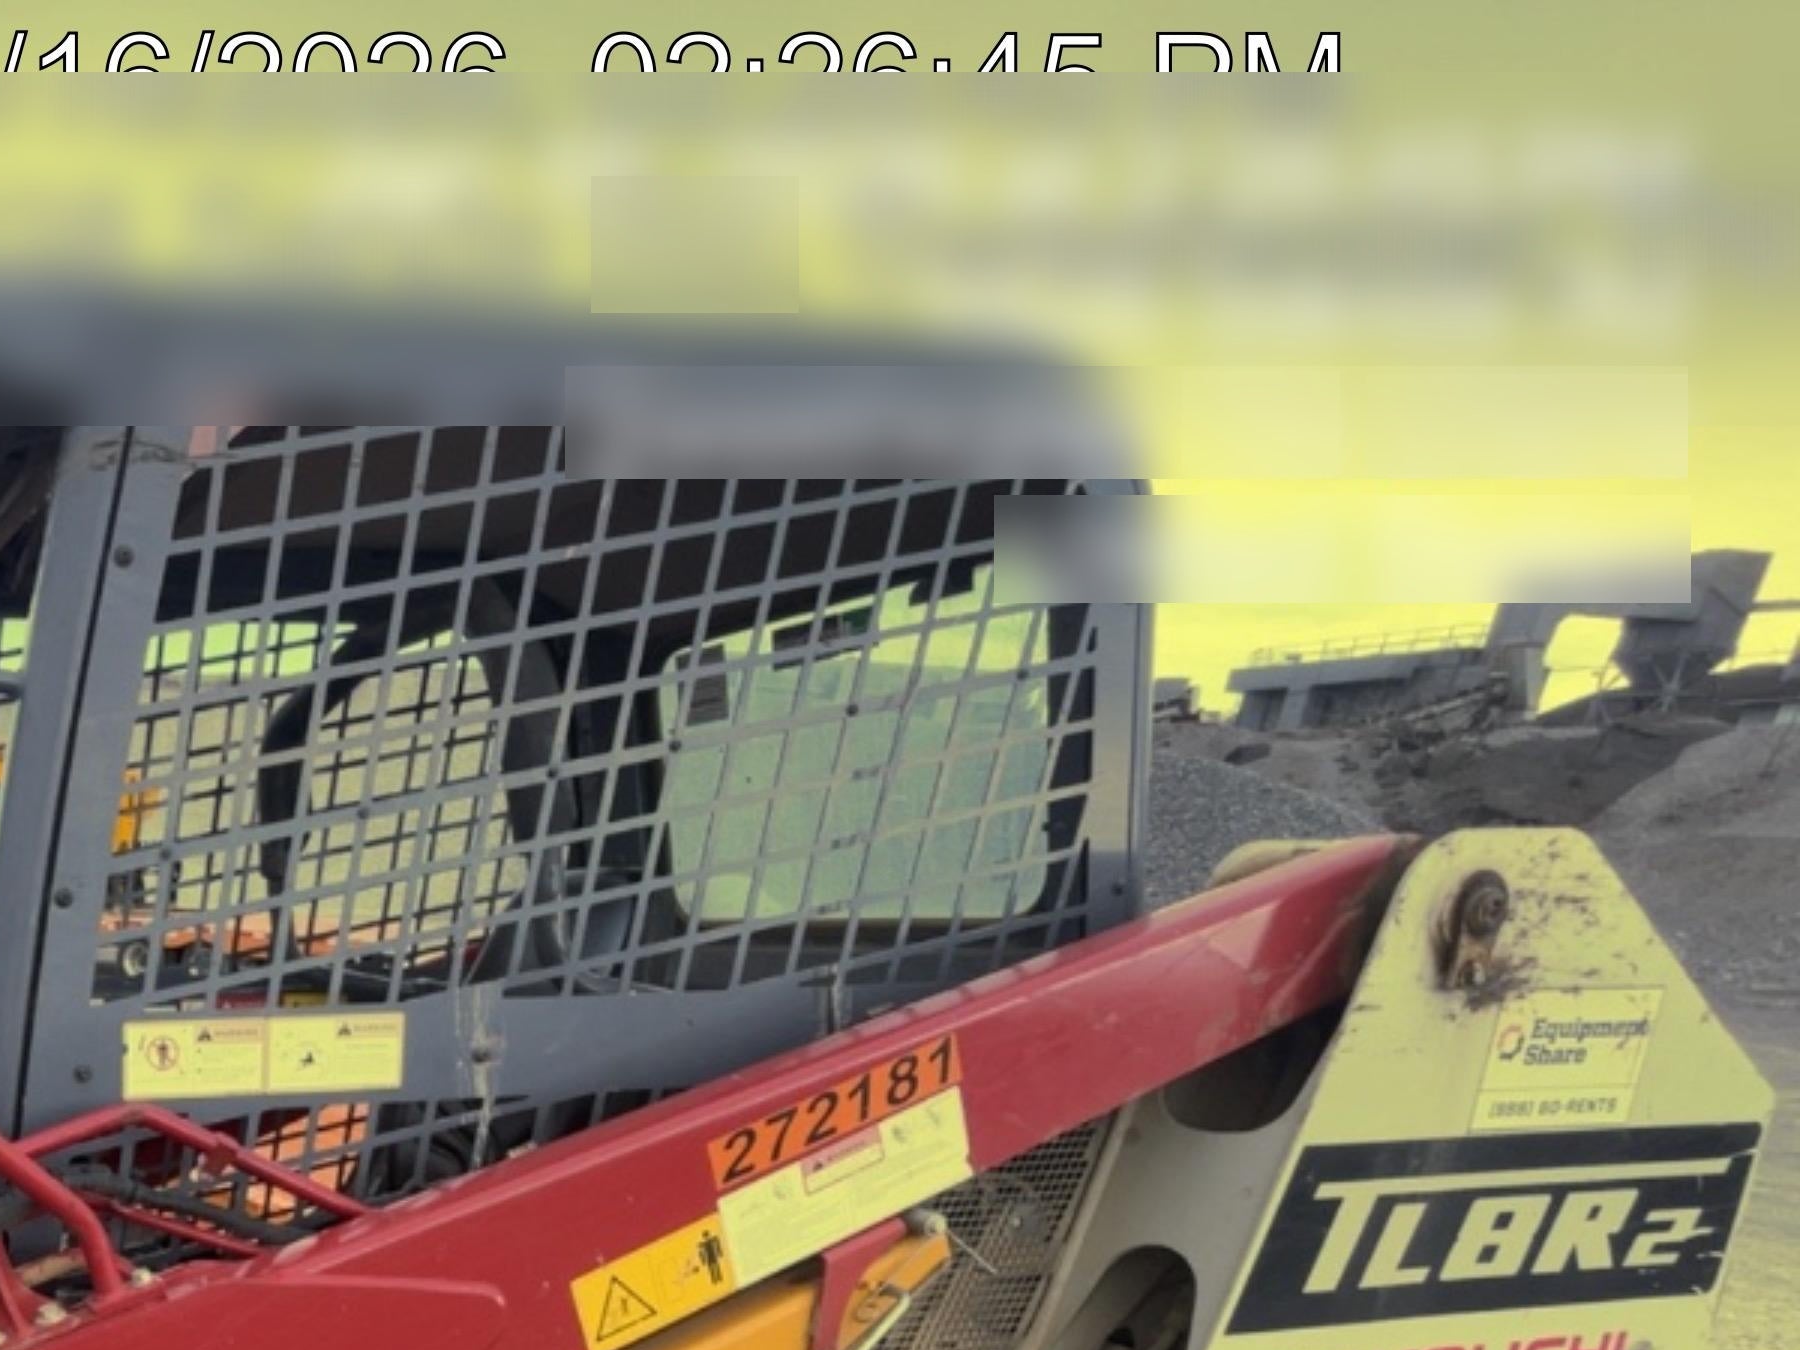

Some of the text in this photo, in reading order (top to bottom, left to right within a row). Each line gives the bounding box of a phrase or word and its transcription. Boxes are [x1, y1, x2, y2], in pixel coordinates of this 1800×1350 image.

[1531, 1017, 1649, 1043] Equipment
[1523, 1044, 1588, 1065] Share
[720, 1036, 953, 1183] 272181
